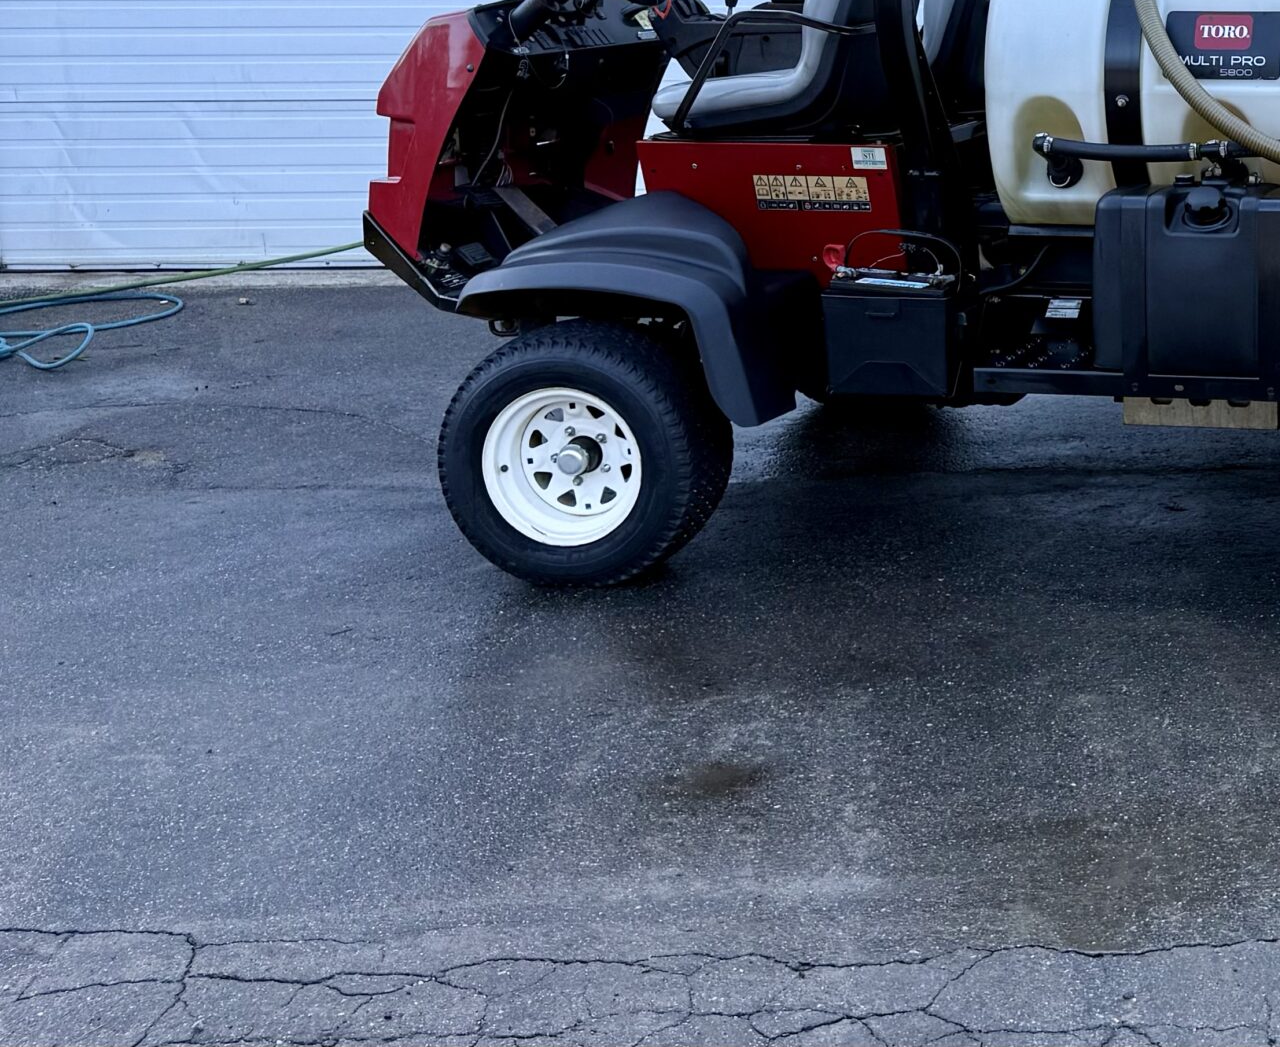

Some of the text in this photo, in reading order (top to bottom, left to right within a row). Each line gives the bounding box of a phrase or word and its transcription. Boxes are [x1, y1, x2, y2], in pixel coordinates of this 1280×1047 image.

[1200, 25, 1249, 39] TORO
[1179, 55, 1266, 66] MULTI PRO
[1219, 68, 1253, 77] 5800
